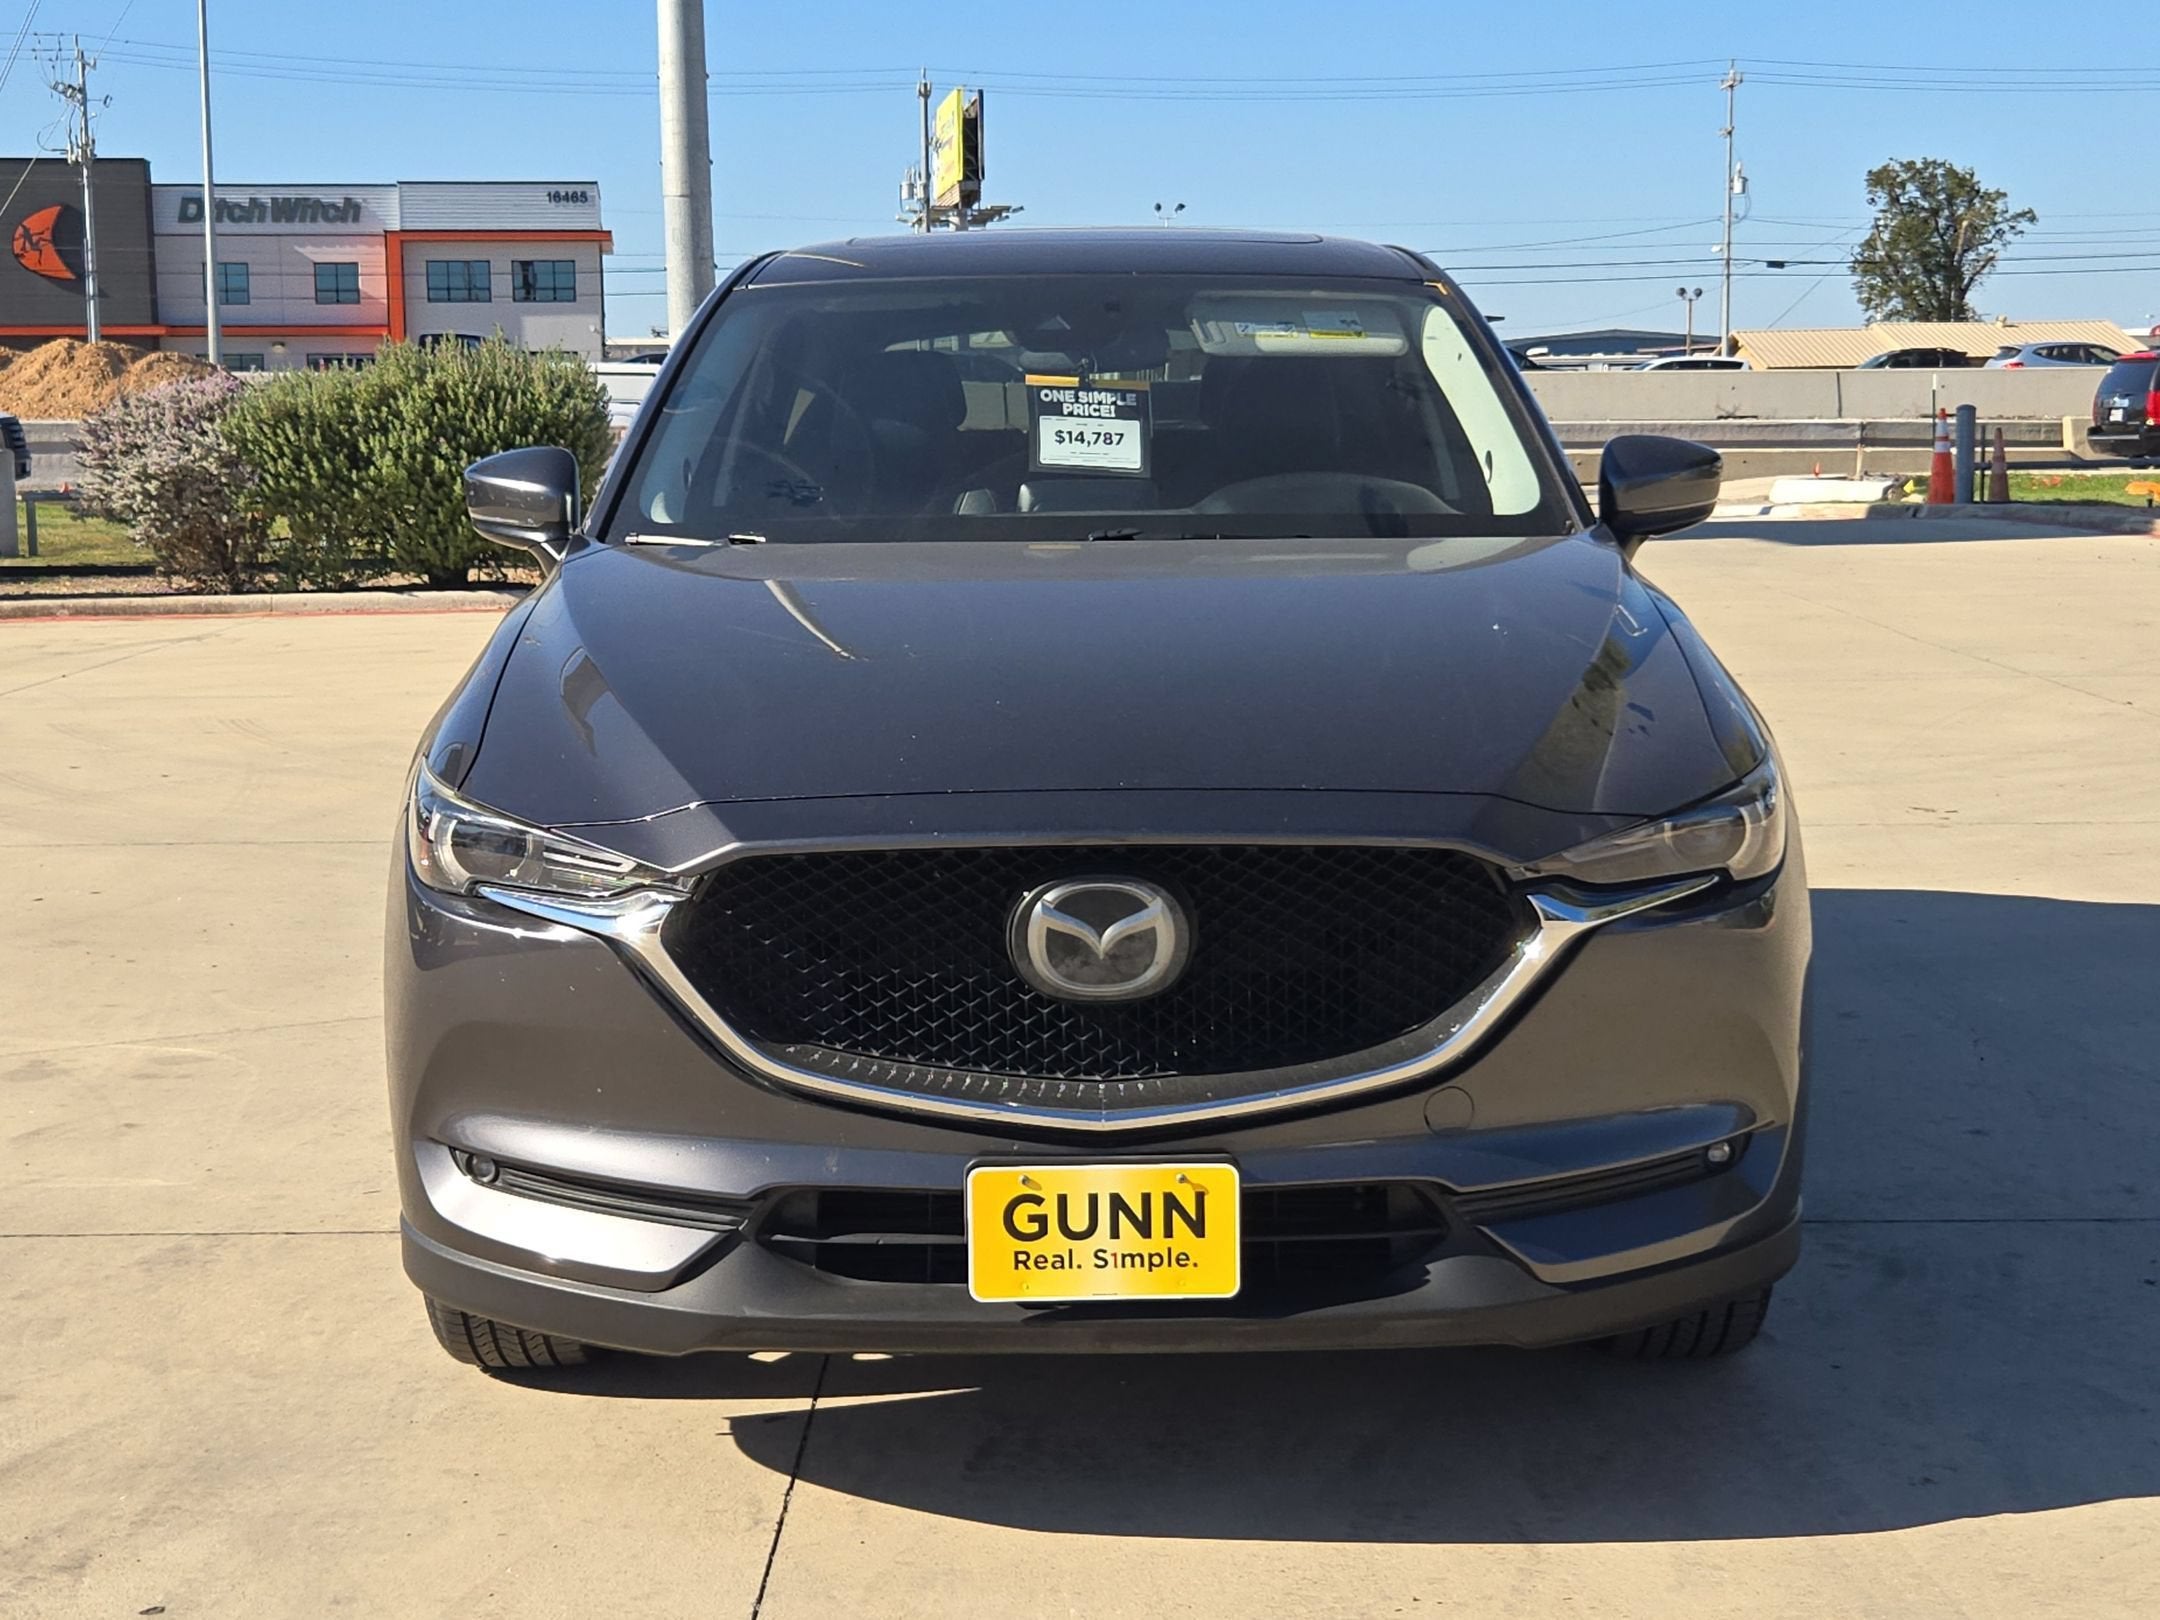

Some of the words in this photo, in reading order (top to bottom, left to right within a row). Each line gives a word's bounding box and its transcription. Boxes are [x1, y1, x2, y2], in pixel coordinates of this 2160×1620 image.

[546, 190, 588, 204] 16465
[178, 197, 266, 223] Dtch
[270, 197, 362, 223] Witch
[1040, 389, 1075, 403] ONE
[1078, 391, 1137, 406] SIMPLE
[1063, 403, 1116, 417] PRICE!
[1055, 429, 1124, 447] $14,787
[1003, 1191, 1205, 1242] GUNN
[1014, 1248, 1082, 1270] Real.
